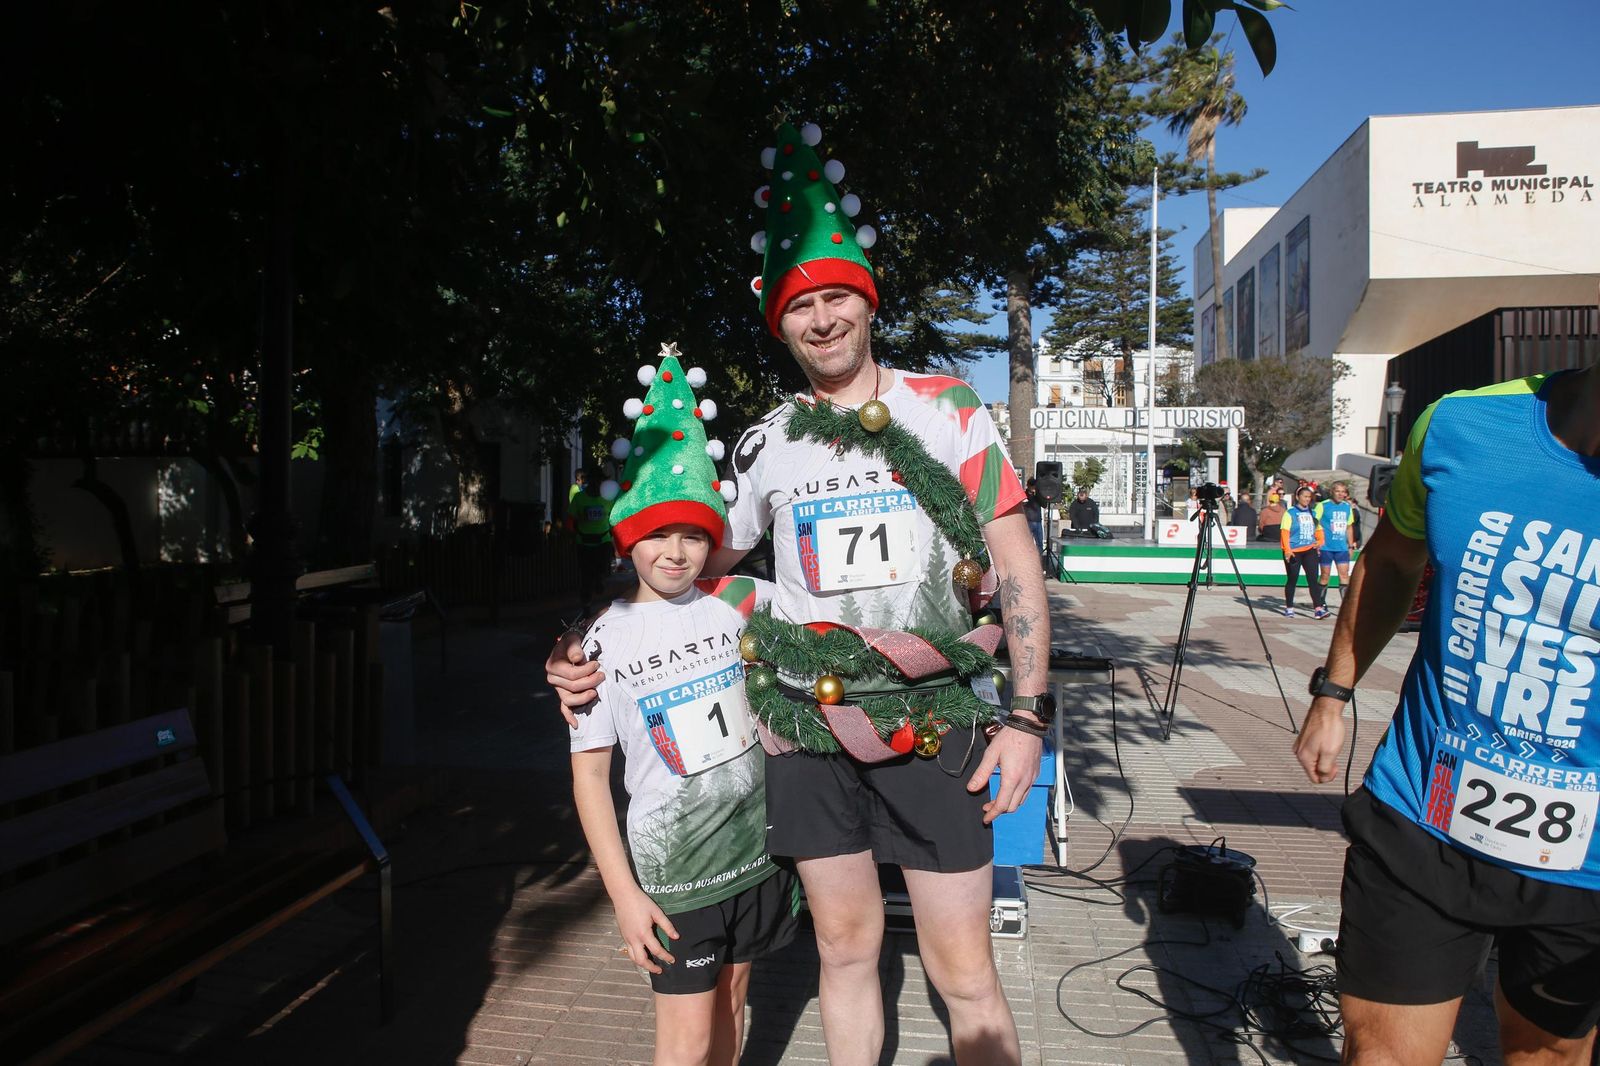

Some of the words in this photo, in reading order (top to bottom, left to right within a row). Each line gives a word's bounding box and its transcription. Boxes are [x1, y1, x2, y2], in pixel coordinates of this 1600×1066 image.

[1412, 180, 1483, 195] TEATRO
[1491, 175, 1594, 192] MUNICIPAL
[1412, 190, 1594, 208] ALAMEDA
[1033, 409, 1109, 429] OFICINA
[1124, 409, 1149, 429] DE
[1163, 408, 1243, 428] TURISMO
[794, 469, 893, 496] USAR
[798, 505, 815, 517] III
[821, 493, 912, 514] CARRERA
[844, 507, 880, 517] TARIFA
[797, 521, 812, 537] SAN
[838, 523, 890, 565] 71
[1447, 511, 1514, 660] CARRERA
[1484, 610, 1600, 687] VES
[632, 672, 669, 689] MENDI
[644, 697, 663, 710] III
[668, 666, 742, 701] CARRERA
[1474, 662, 1591, 738] TRE
[646, 711, 665, 728] SAN
[707, 701, 729, 738] 1
[1503, 725, 1543, 744] TARIFA
[1546, 737, 1576, 750] 2024
[1436, 749, 1458, 771] SAN
[1444, 733, 1467, 752] III
[1474, 746, 1597, 785] CARRERA
[1432, 763, 1453, 791] SIL
[1503, 768, 1555, 789] TARIFA
[1565, 783, 1597, 792] 2024
[1459, 778, 1576, 844] 228
[694, 869, 738, 889] AUSARTAK
